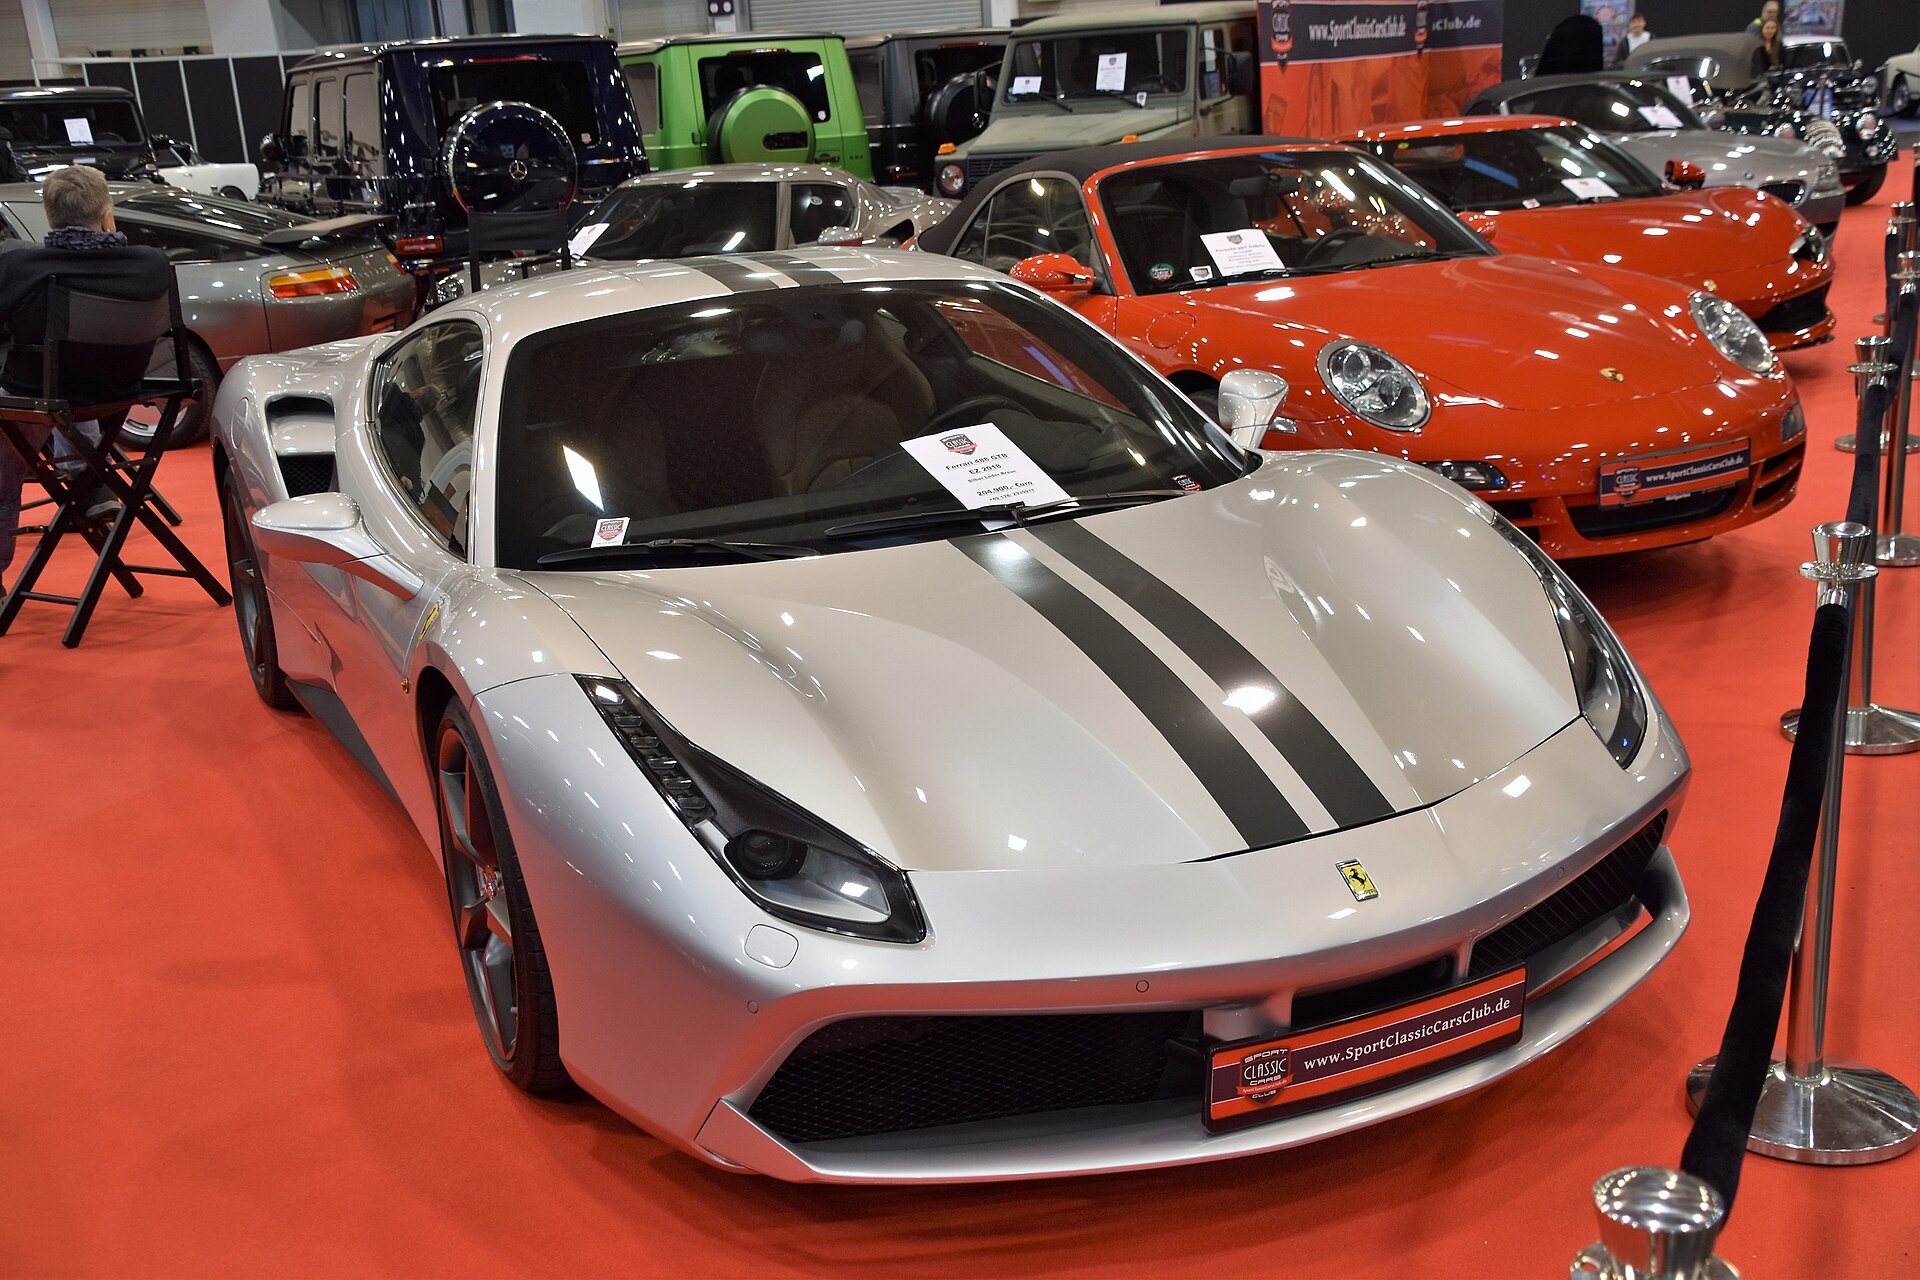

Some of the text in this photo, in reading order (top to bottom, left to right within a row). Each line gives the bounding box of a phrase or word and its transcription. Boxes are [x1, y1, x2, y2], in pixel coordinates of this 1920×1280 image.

[1308, 15, 1407, 47] www.SportClassicCarsClub.de
[945, 453, 1008, 471] Ferrari 488 GTB
[981, 463, 1002, 472] 2018
[1645, 455, 1745, 483] www.SportClassicCarsClub.de
[1303, 997, 1511, 1071] www.SportClassicCarsClub.de
[1244, 1049, 1288, 1064] SPORT
[1243, 1057, 1287, 1080] CLASSIC
[1249, 1074, 1282, 1086] CARS
[1251, 1089, 1277, 1099] CLUB
